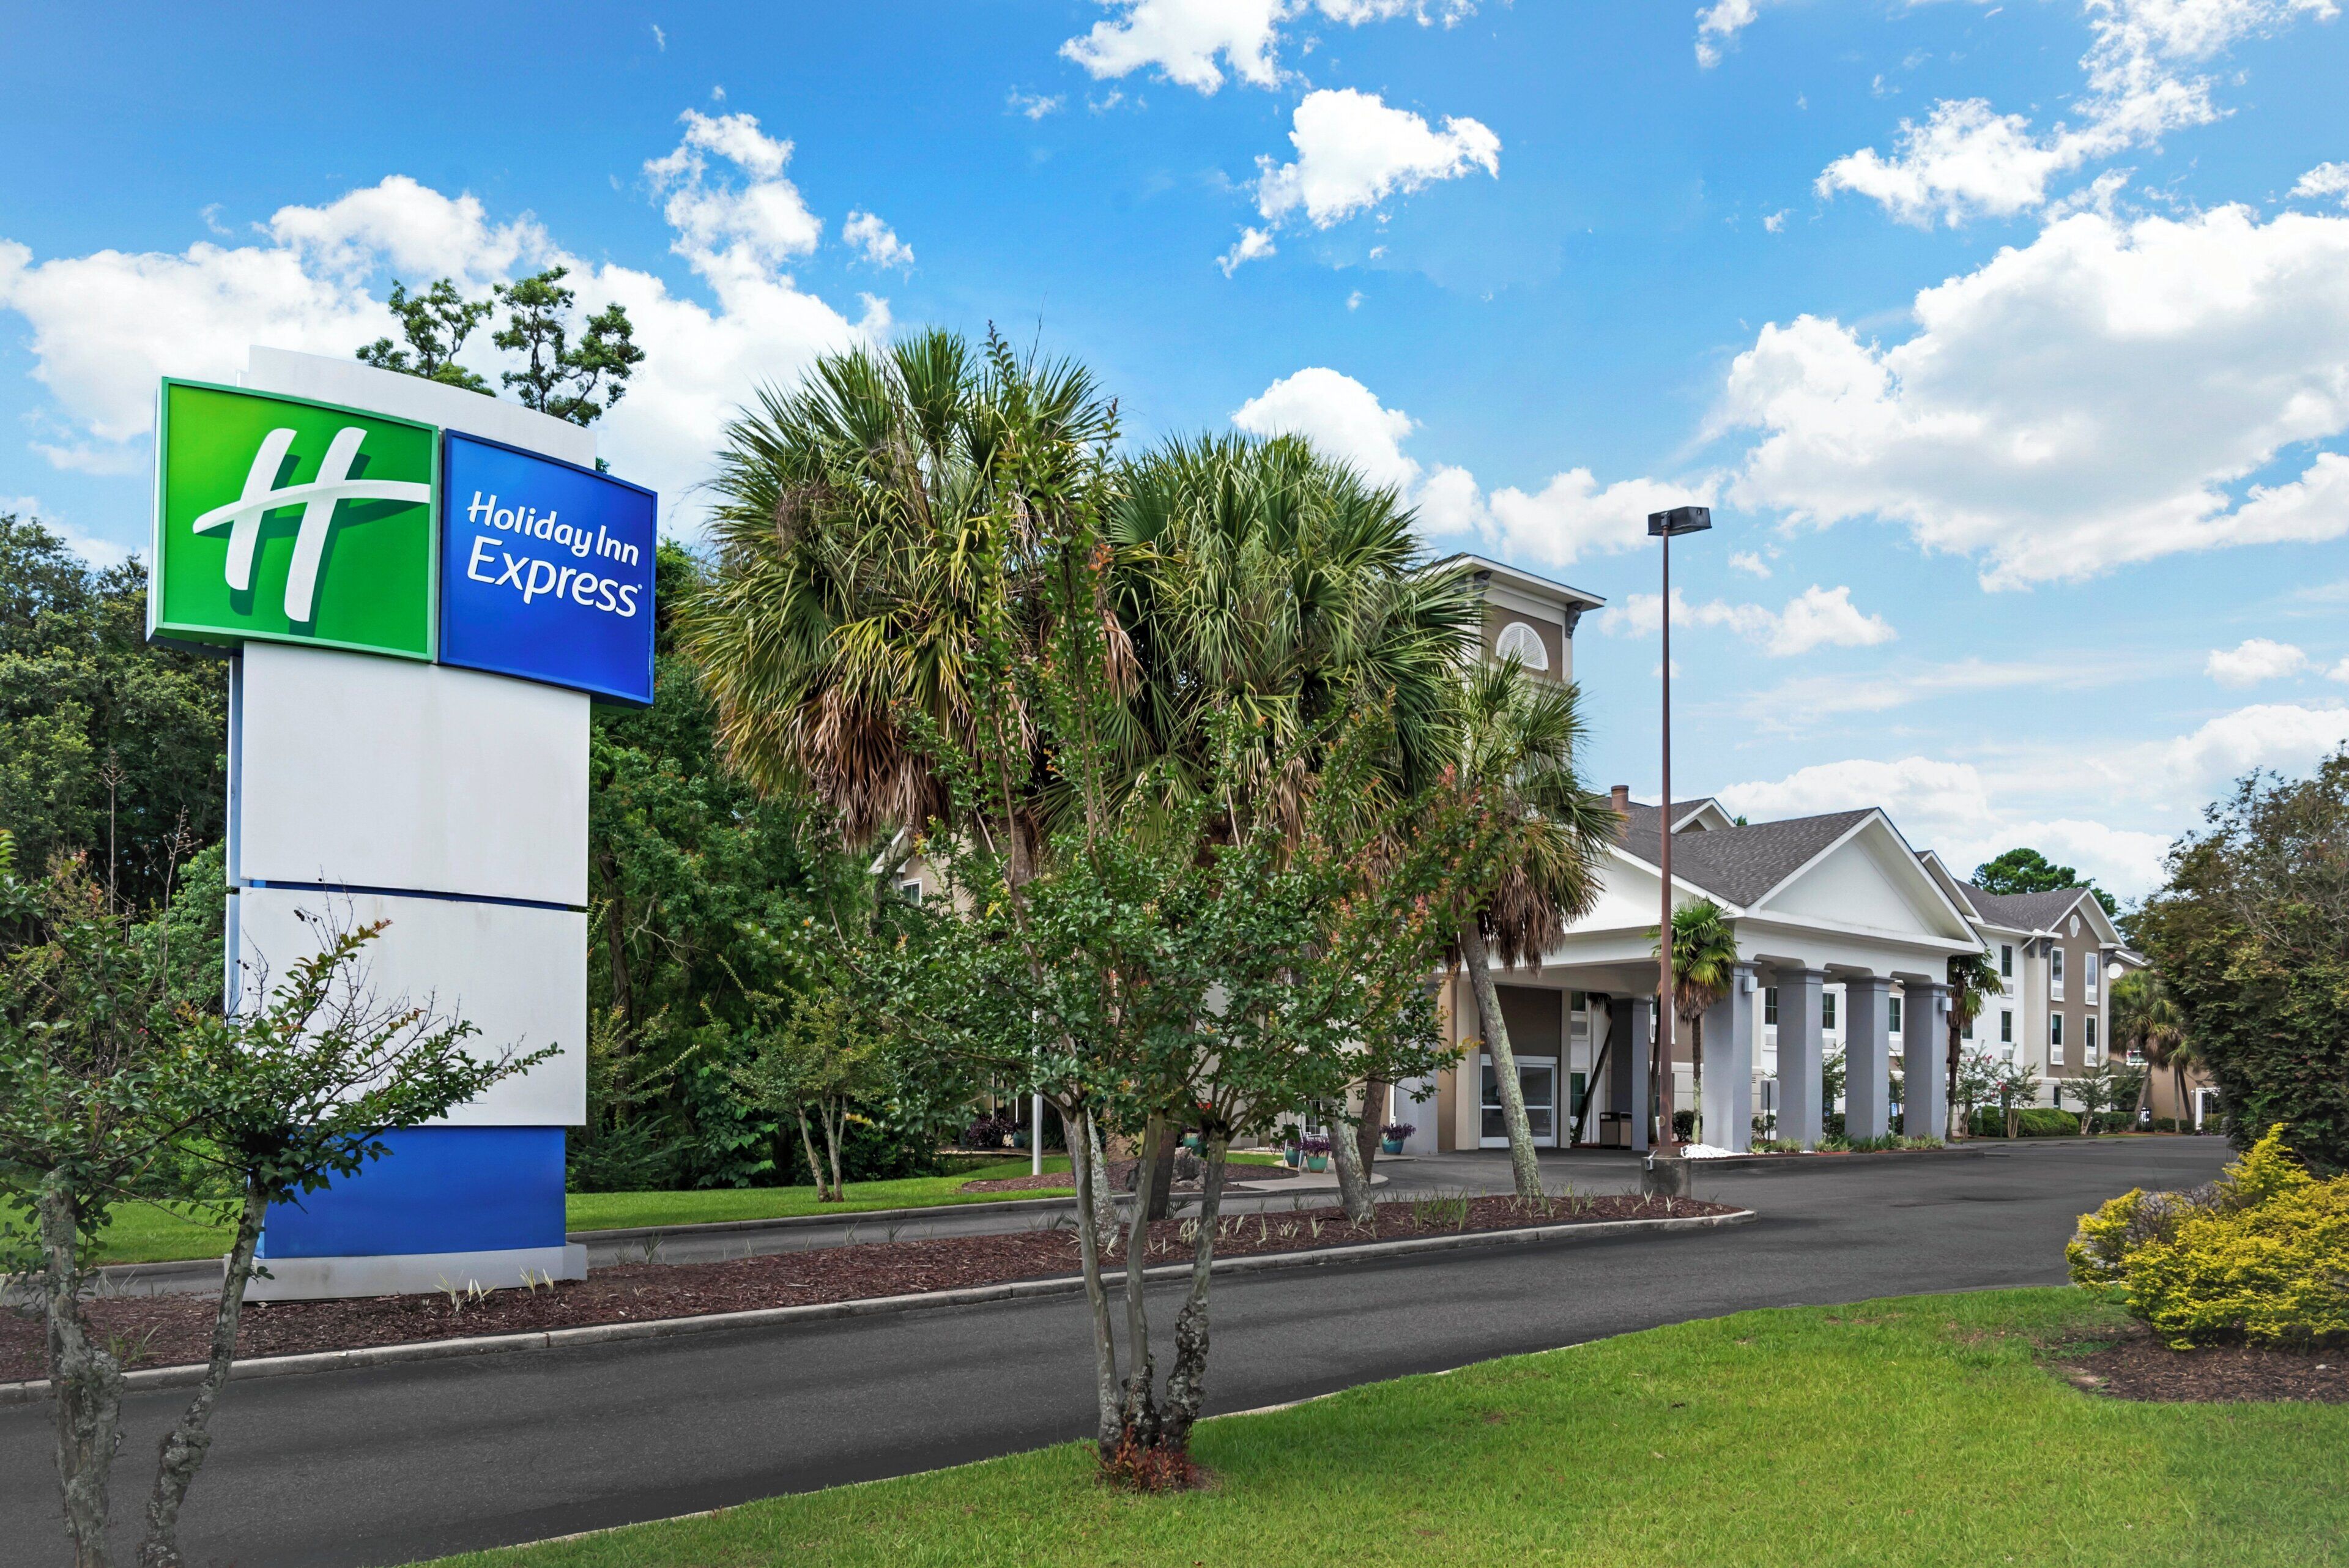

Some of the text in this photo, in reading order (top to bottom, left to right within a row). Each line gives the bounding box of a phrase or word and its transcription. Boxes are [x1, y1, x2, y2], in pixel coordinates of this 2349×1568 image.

[192, 426, 431, 622] H
[467, 491, 639, 567] Holiday Inn
